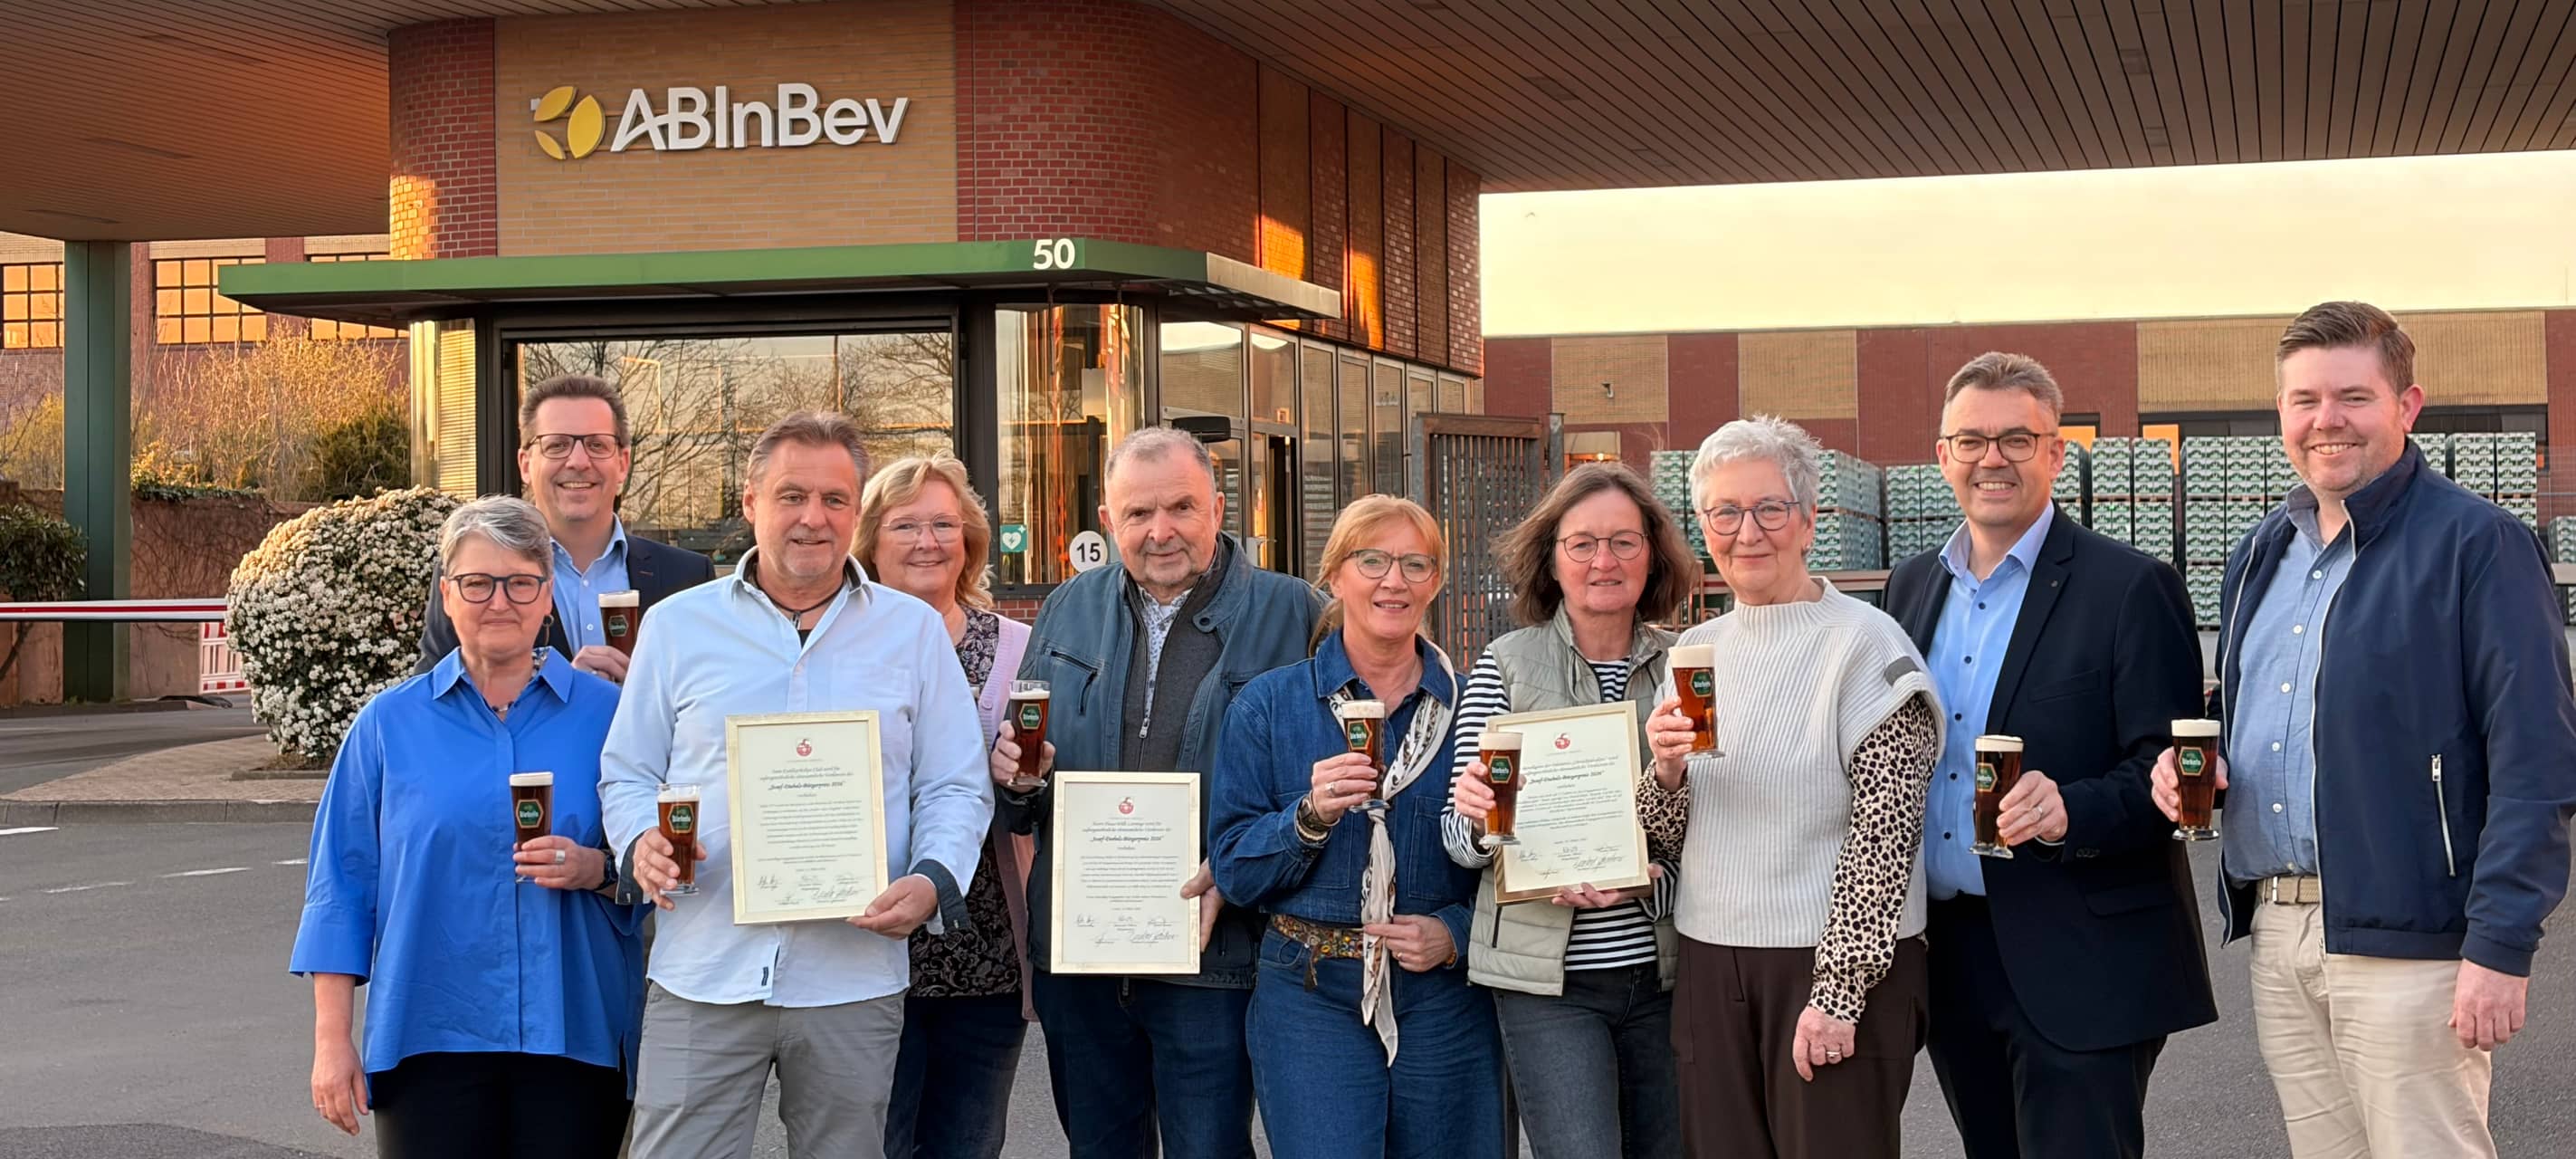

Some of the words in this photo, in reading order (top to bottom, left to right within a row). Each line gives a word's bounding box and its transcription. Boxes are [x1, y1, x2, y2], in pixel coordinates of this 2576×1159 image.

[610, 83, 910, 152] ABInBev
[1033, 238, 1075, 270] 50
[1076, 542, 1101, 562] 15
